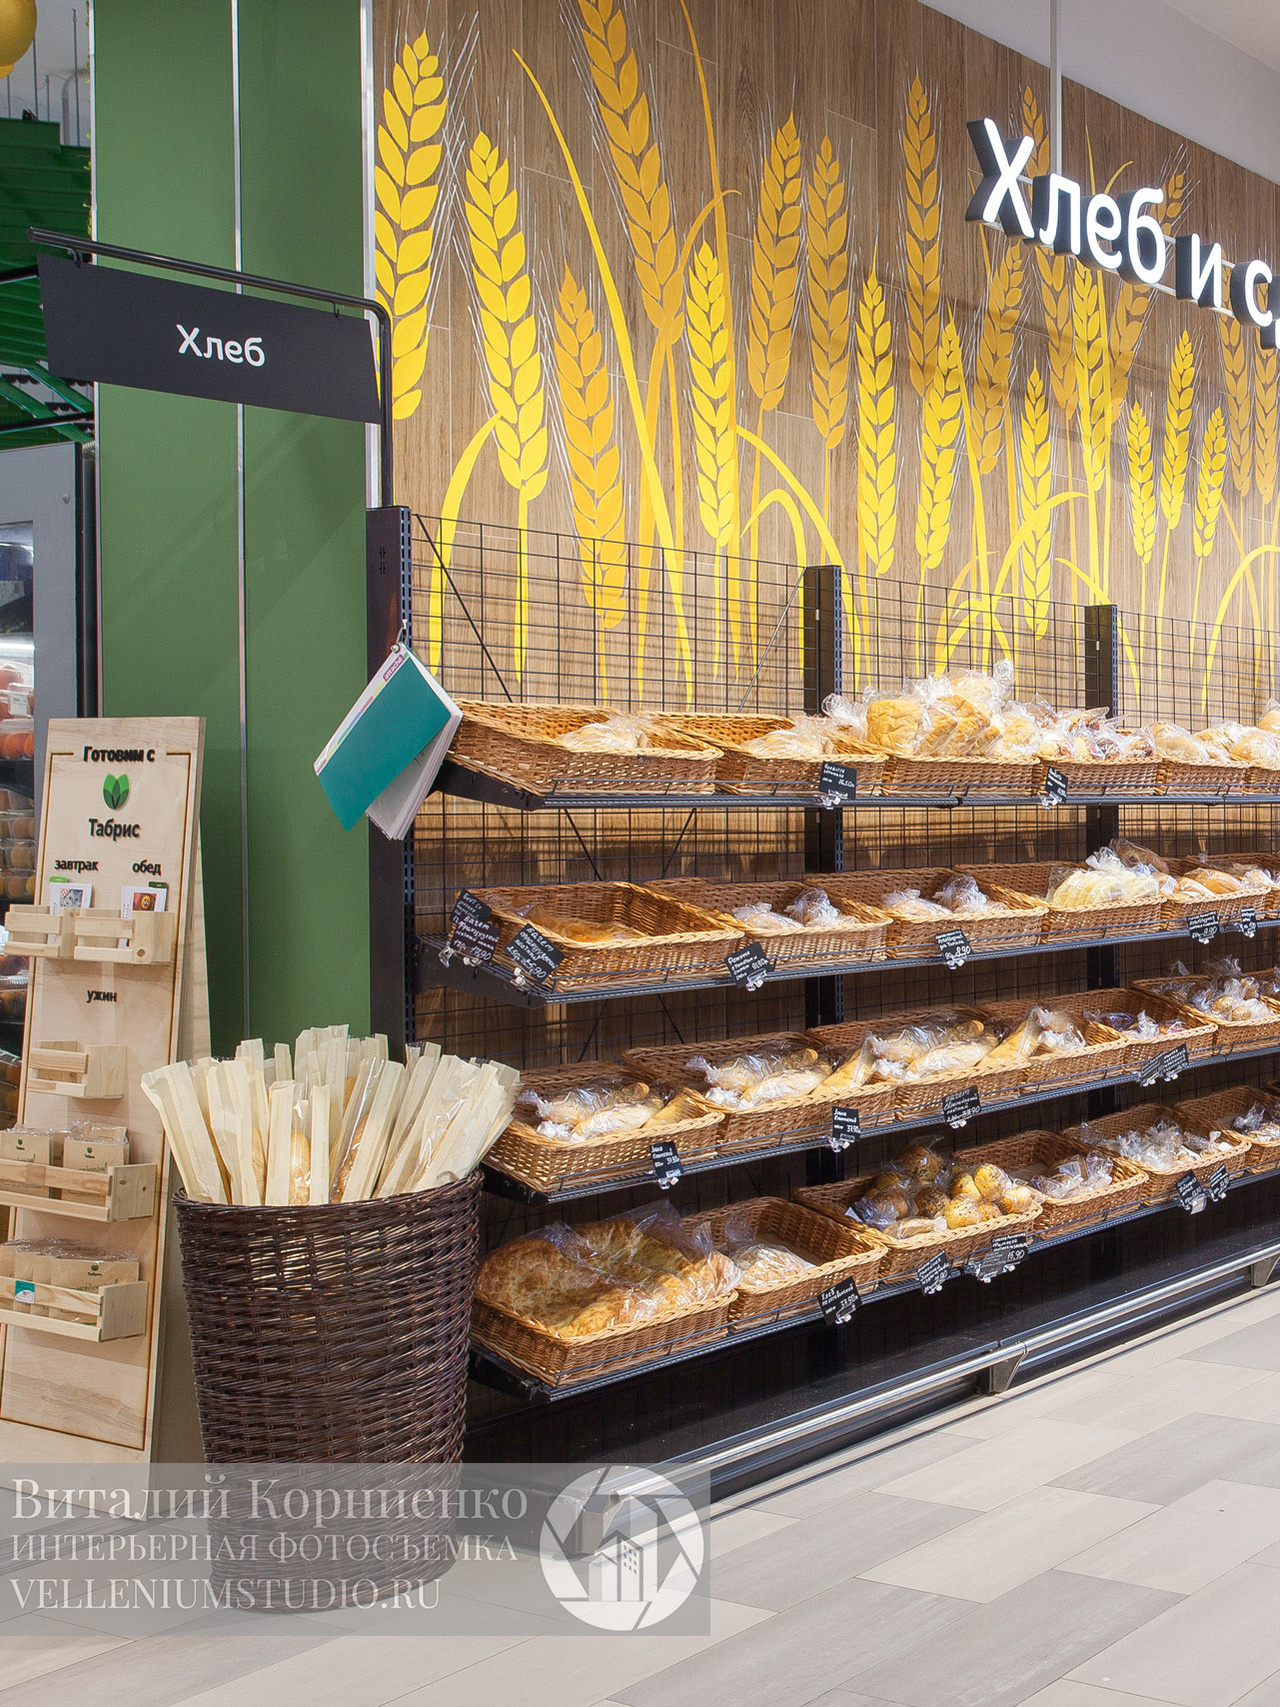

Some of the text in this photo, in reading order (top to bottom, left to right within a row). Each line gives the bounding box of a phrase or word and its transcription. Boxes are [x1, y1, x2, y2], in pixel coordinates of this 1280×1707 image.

[975, 117, 1167, 285] Хлеб
[1180, 232, 1222, 308] и
[176, 324, 265, 367] Хлеб
[83, 746, 156, 762] Готовим с
[88, 818, 141, 841] Табрис
[54, 859, 162, 876] завтрак обед
[86, 987, 117, 1003] ужин
